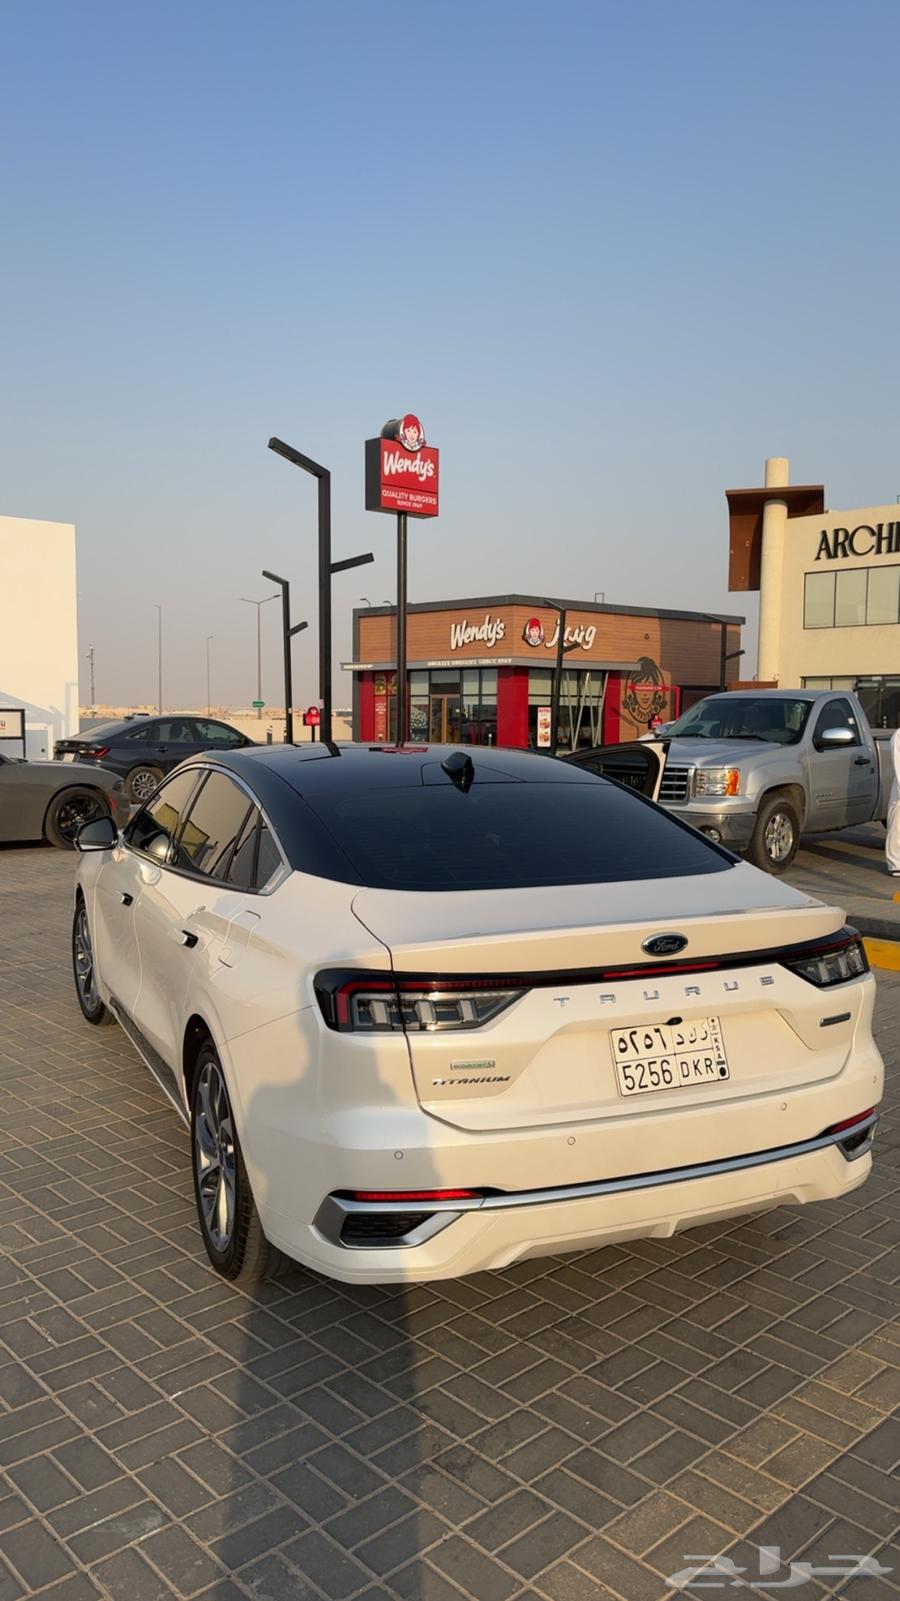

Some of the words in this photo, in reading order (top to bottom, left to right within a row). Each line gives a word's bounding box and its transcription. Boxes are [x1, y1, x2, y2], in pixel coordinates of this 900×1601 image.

[384, 451, 434, 481] Wendy's
[382, 489, 408, 500] QUALITY
[409, 493, 437, 505] BURGERS
[450, 615, 505, 650] Wendy's
[553, 975, 774, 1007] TAURUS
[618, 1028, 667, 1055] ٥٢٥٦
[432, 1075, 511, 1086] TITANIUM
[622, 1059, 673, 1091] 5256
[680, 1057, 714, 1078] DKR
